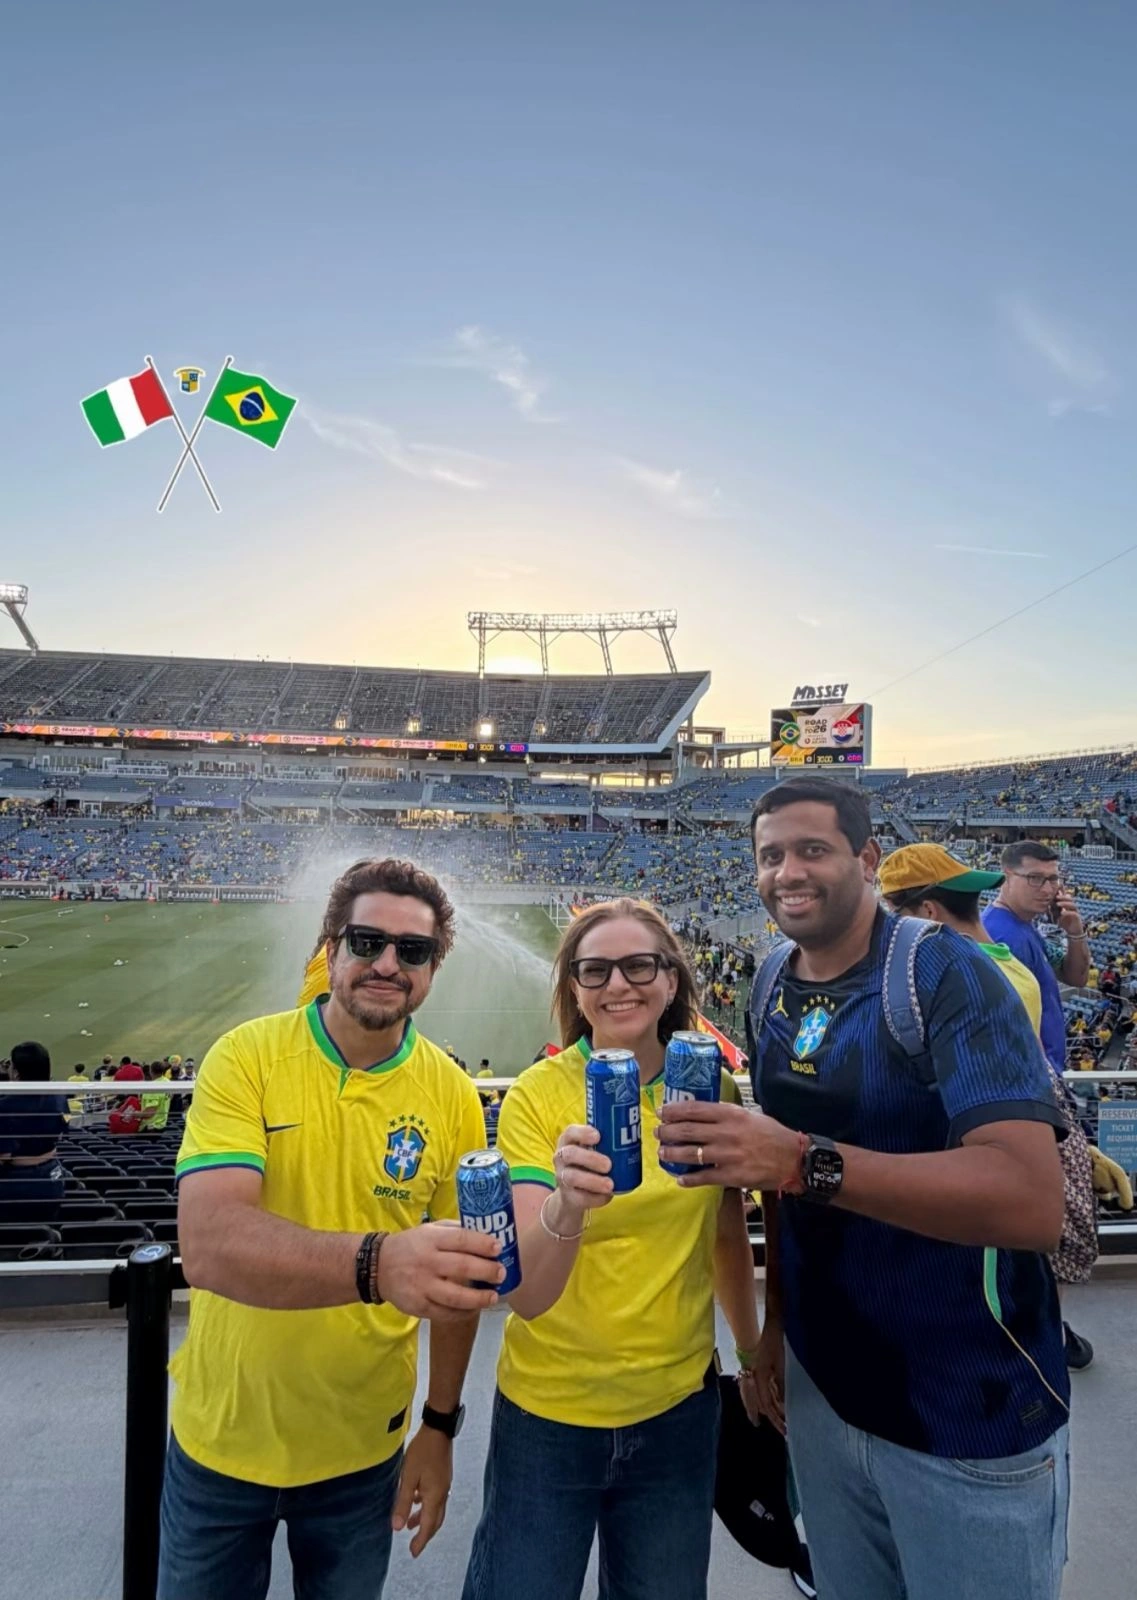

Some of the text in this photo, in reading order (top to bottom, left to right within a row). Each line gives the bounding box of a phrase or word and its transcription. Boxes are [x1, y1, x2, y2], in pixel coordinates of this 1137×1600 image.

[793, 684, 848, 700] MASSEY
[813, 725, 827, 733] 26
[790, 1060, 817, 1075] BRASIL
[397, 1148, 413, 1158] CBF
[373, 1185, 412, 1200] BRASIL
[462, 1211, 508, 1233] BUD
